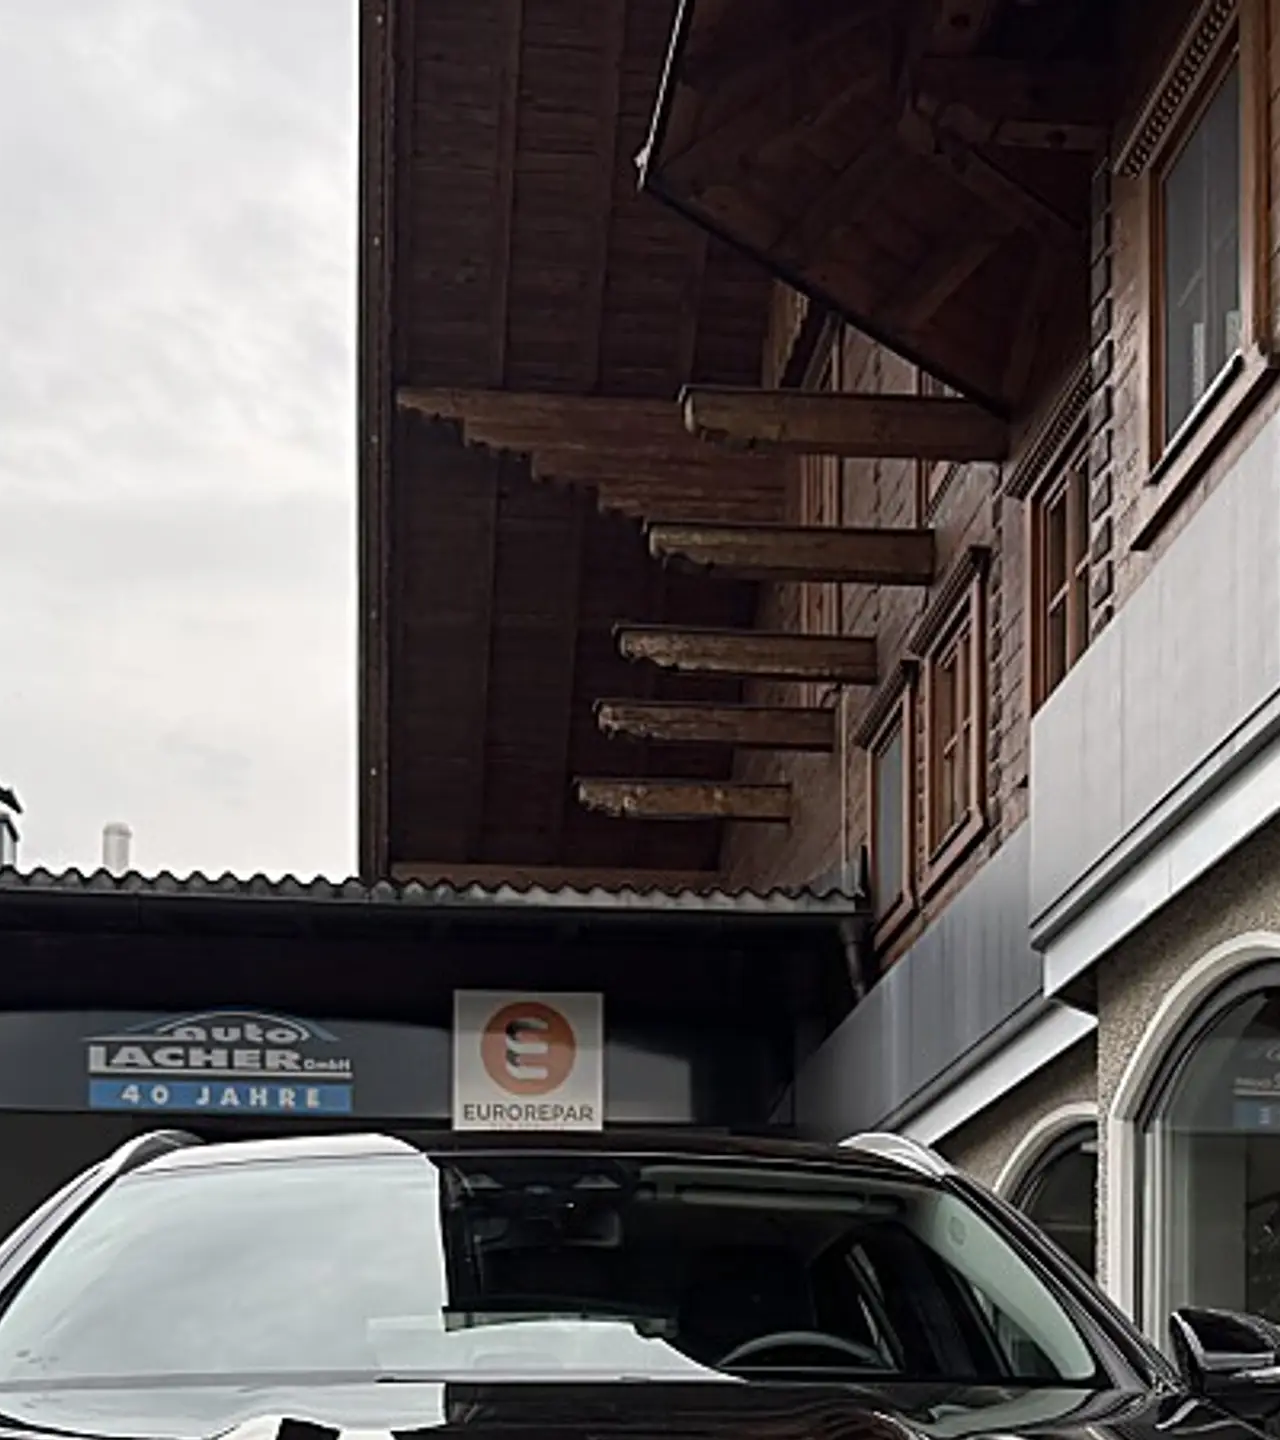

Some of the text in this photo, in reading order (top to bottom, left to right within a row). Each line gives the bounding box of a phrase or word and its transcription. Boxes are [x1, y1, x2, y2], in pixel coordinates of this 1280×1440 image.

[170, 1022, 299, 1045] auto
[88, 1045, 302, 1074] LACHER
[121, 1084, 322, 1109] 40 JAHRE
[463, 1103, 595, 1122] EUROREPAR
